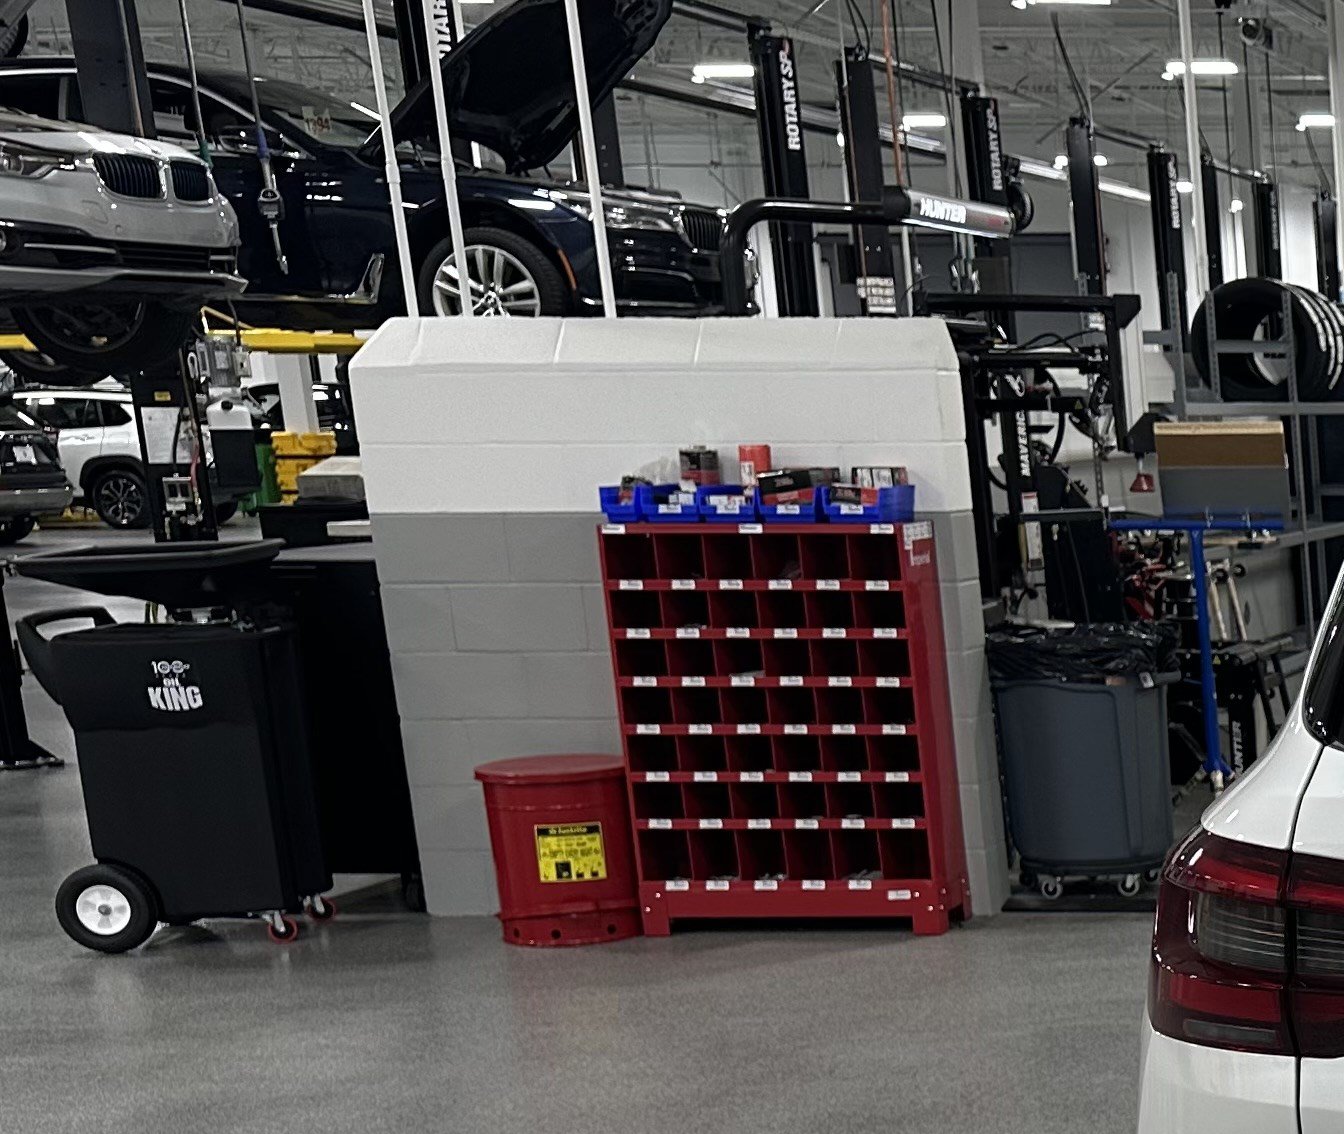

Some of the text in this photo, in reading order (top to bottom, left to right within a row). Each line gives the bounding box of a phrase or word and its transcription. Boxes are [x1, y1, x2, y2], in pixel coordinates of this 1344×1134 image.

[782, 80, 801, 151] ROTARY
[988, 132, 1003, 191] ROTARY
[920, 197, 967, 224] HUNTER
[1015, 410, 1031, 477] MAVERIC
[148, 686, 203, 711] KING
